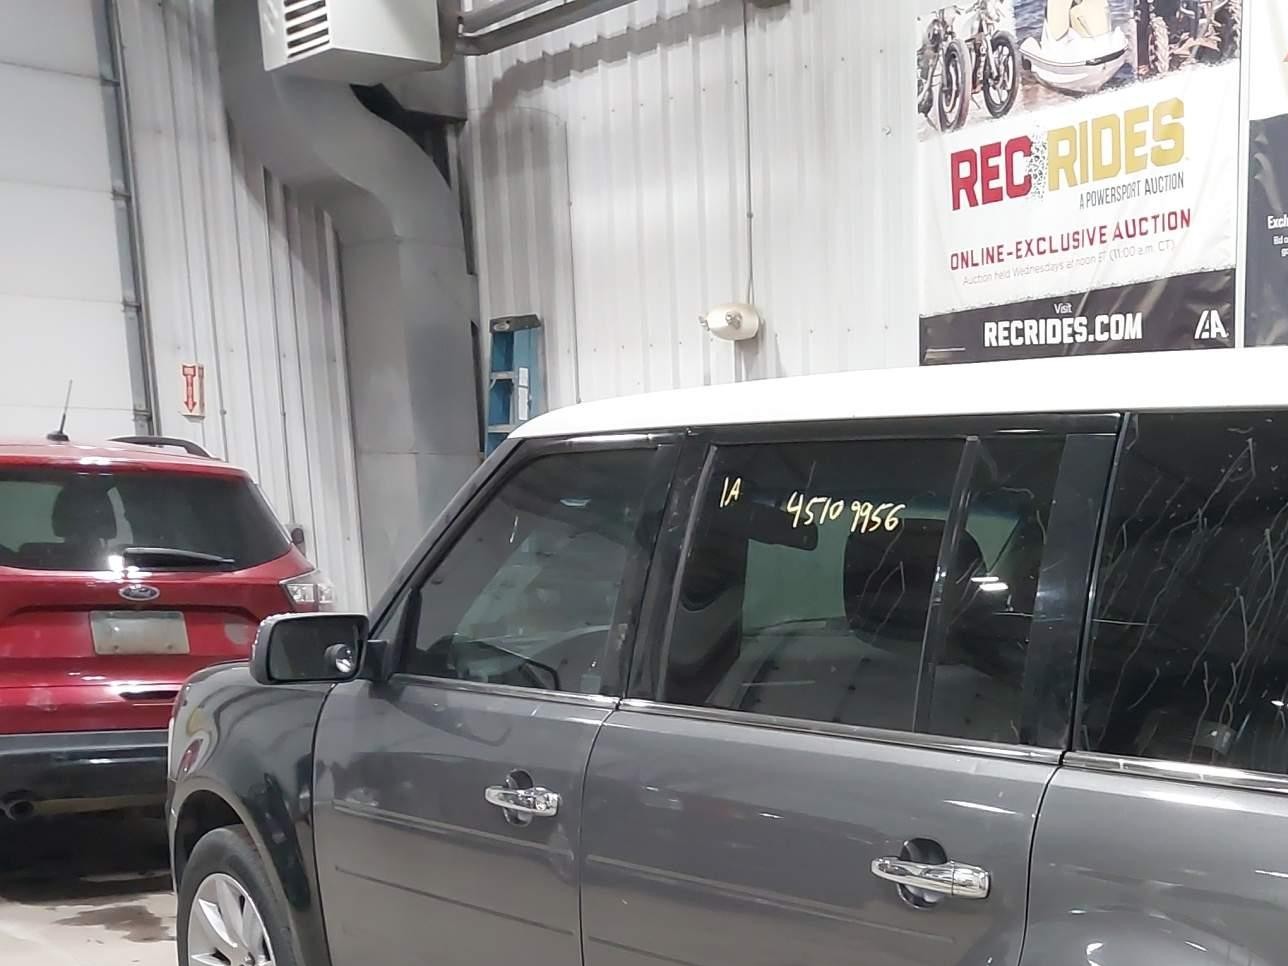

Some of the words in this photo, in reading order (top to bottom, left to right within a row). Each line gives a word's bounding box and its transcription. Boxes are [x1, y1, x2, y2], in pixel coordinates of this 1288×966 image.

[951, 136, 1033, 211] REC
[1047, 97, 1185, 192] RIDES
[1086, 180, 1141, 208] POWERSPORT
[1144, 171, 1184, 196] AUCTION
[951, 224, 1107, 271] ONLINE-EXCLUSIVE
[1112, 208, 1191, 242] AUCTION
[1273, 235, 1283, 245] Bid
[1054, 302, 1072, 315] Visit
[984, 312, 1143, 347] RECRIDES.COM
[786, 491, 845, 528] 4510
[850, 500, 905, 533] 9956
